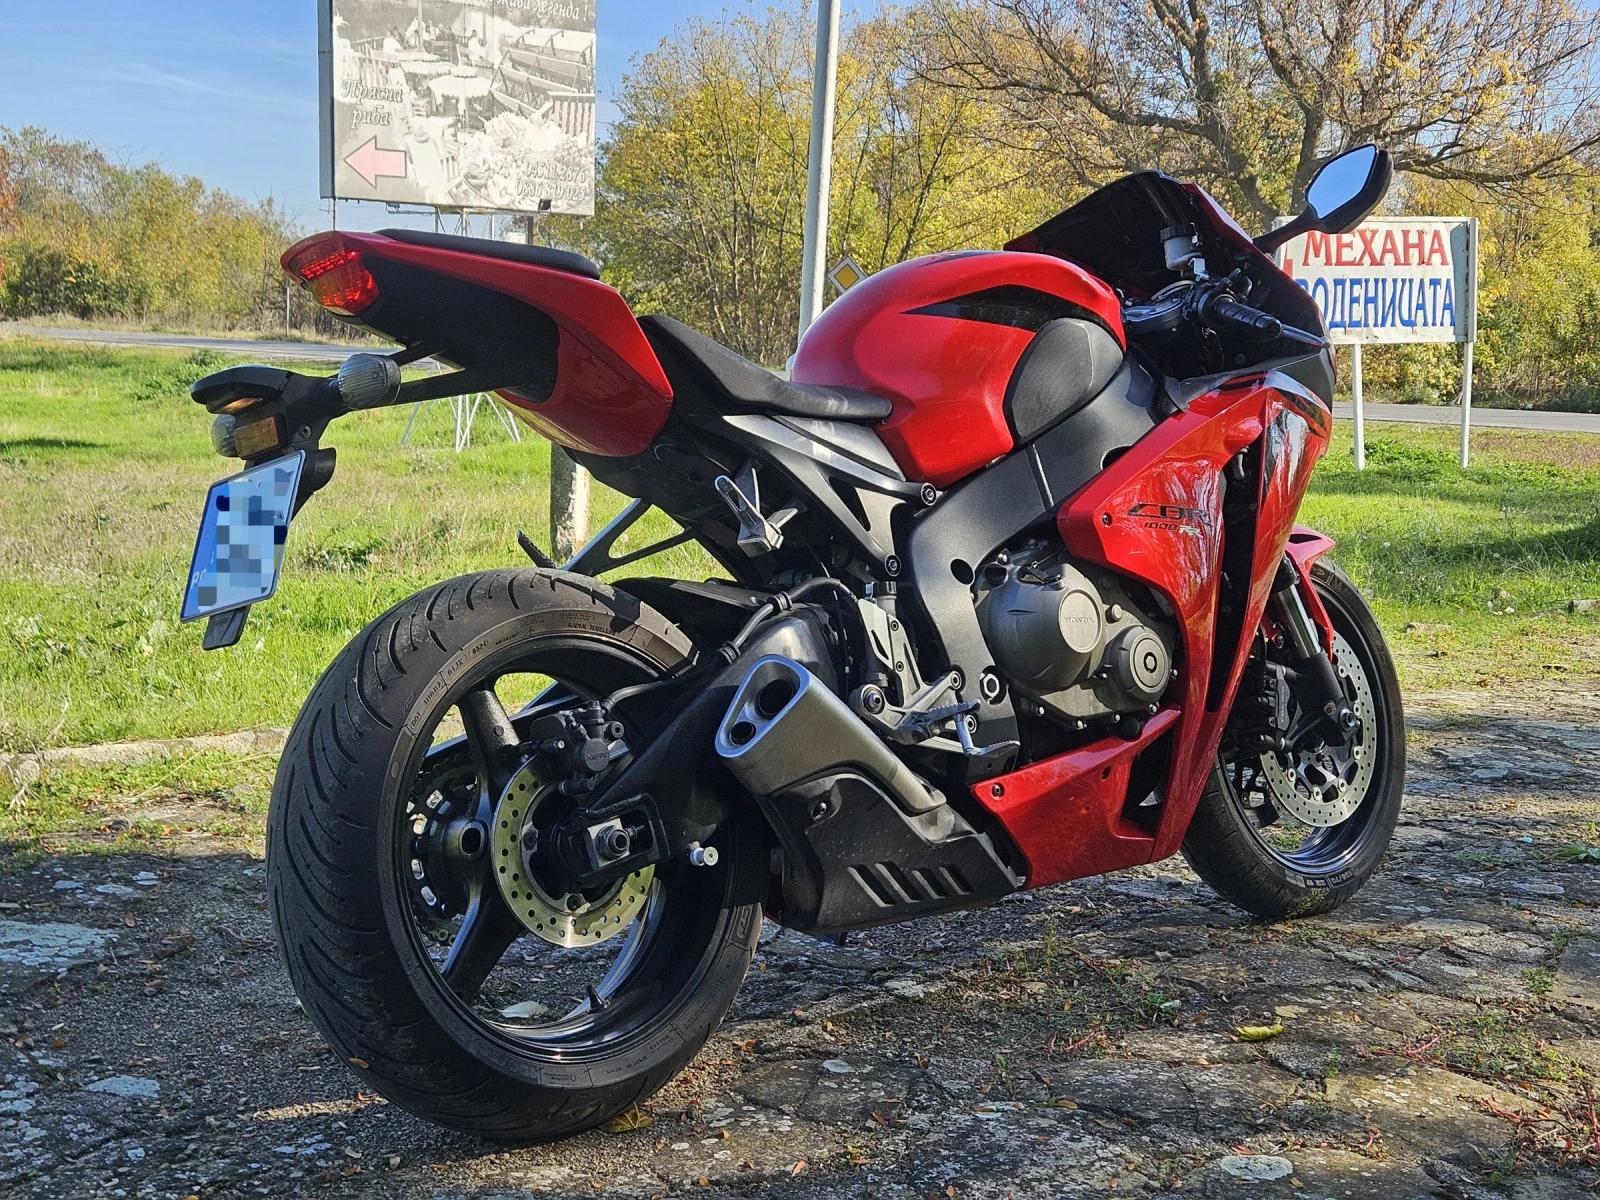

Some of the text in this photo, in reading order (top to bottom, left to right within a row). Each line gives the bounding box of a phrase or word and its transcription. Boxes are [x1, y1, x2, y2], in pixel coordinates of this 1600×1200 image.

[341, 79, 404, 105] Прясна
[351, 104, 391, 130] риба
[559, 165, 586, 184] 2876
[515, 180, 542, 198] 0886
[566, 185, 586, 201] 025
[1302, 230, 1449, 266] МЕХАНА
[1128, 502, 1213, 528] CBR
[1063, 616, 1095, 624] HONDA
